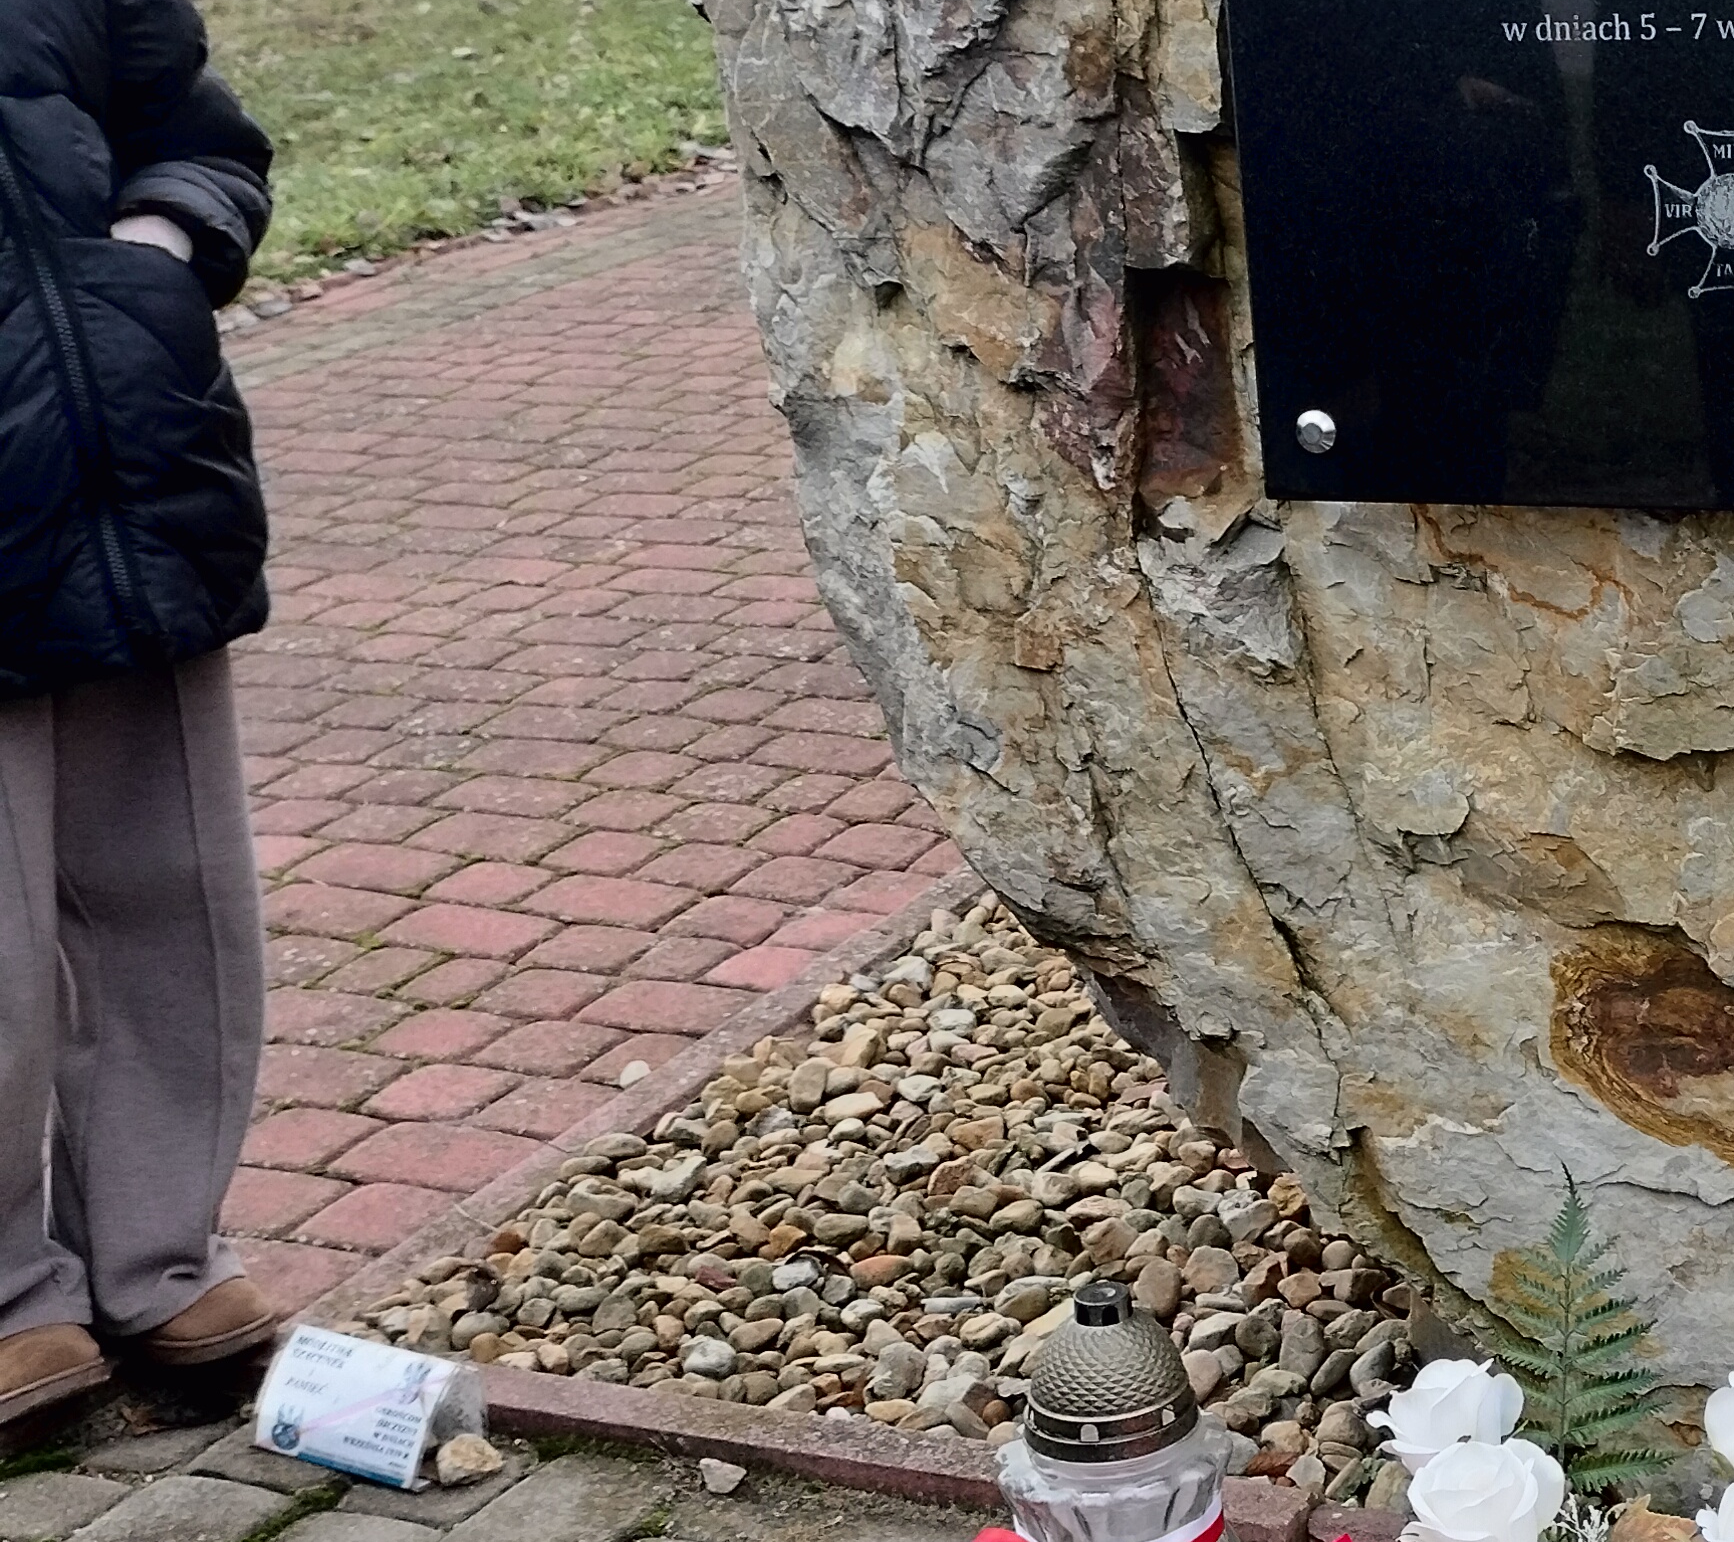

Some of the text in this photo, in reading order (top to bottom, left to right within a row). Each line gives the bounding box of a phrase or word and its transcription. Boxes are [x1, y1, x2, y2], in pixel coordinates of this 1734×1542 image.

[1501, 22, 1528, 42] w
[1535, 12, 1631, 42] dniach
[1640, 12, 1657, 41] 5
[1690, 12, 1708, 40] 7
[1664, 203, 1693, 218] VIR
